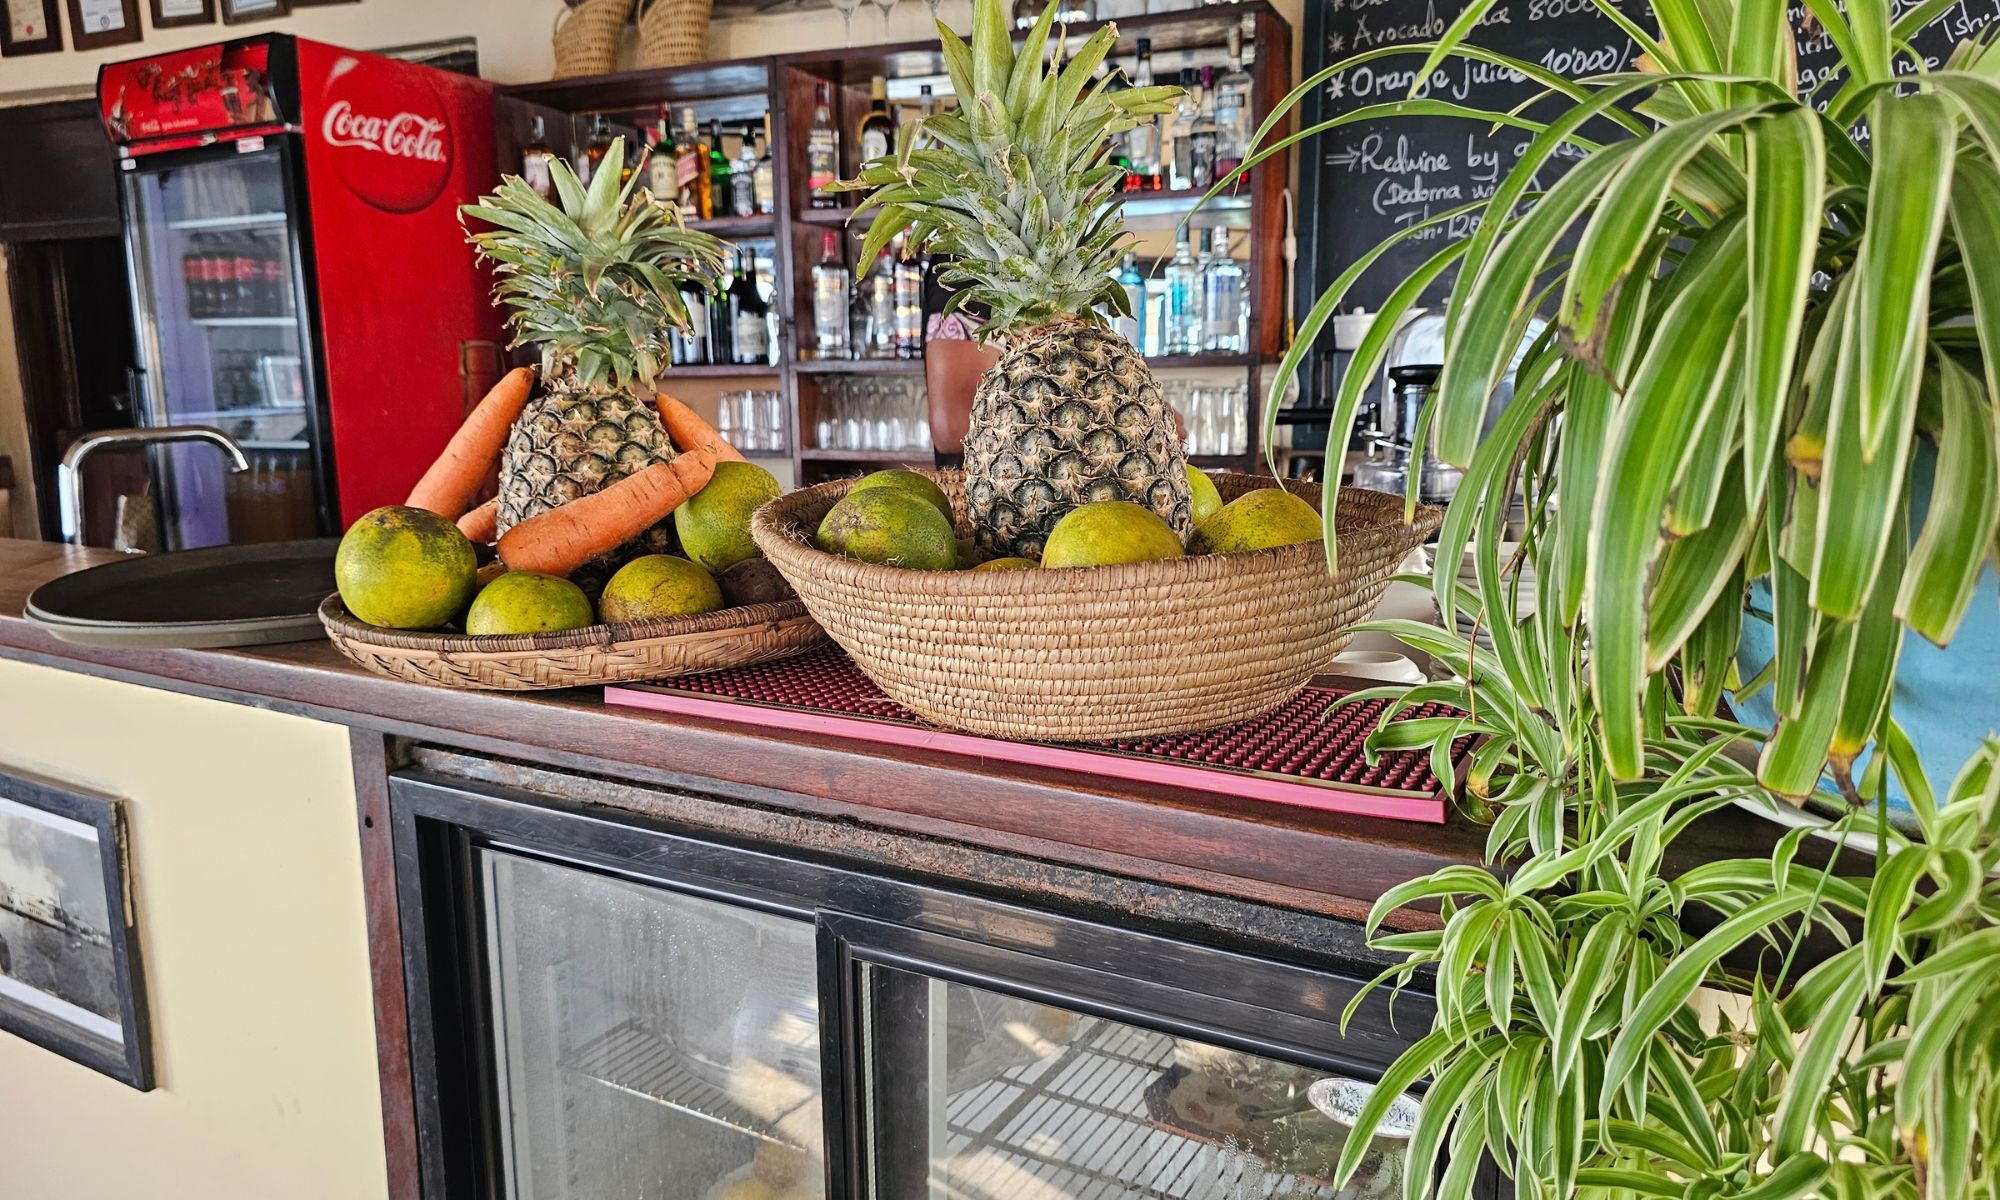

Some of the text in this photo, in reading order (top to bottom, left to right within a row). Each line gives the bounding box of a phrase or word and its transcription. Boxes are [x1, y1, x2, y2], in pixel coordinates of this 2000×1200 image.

[1352, 0, 1445, 49] Avocado
[322, 100, 447, 163] Coca-Cola
[1467, 133, 1499, 181] by
